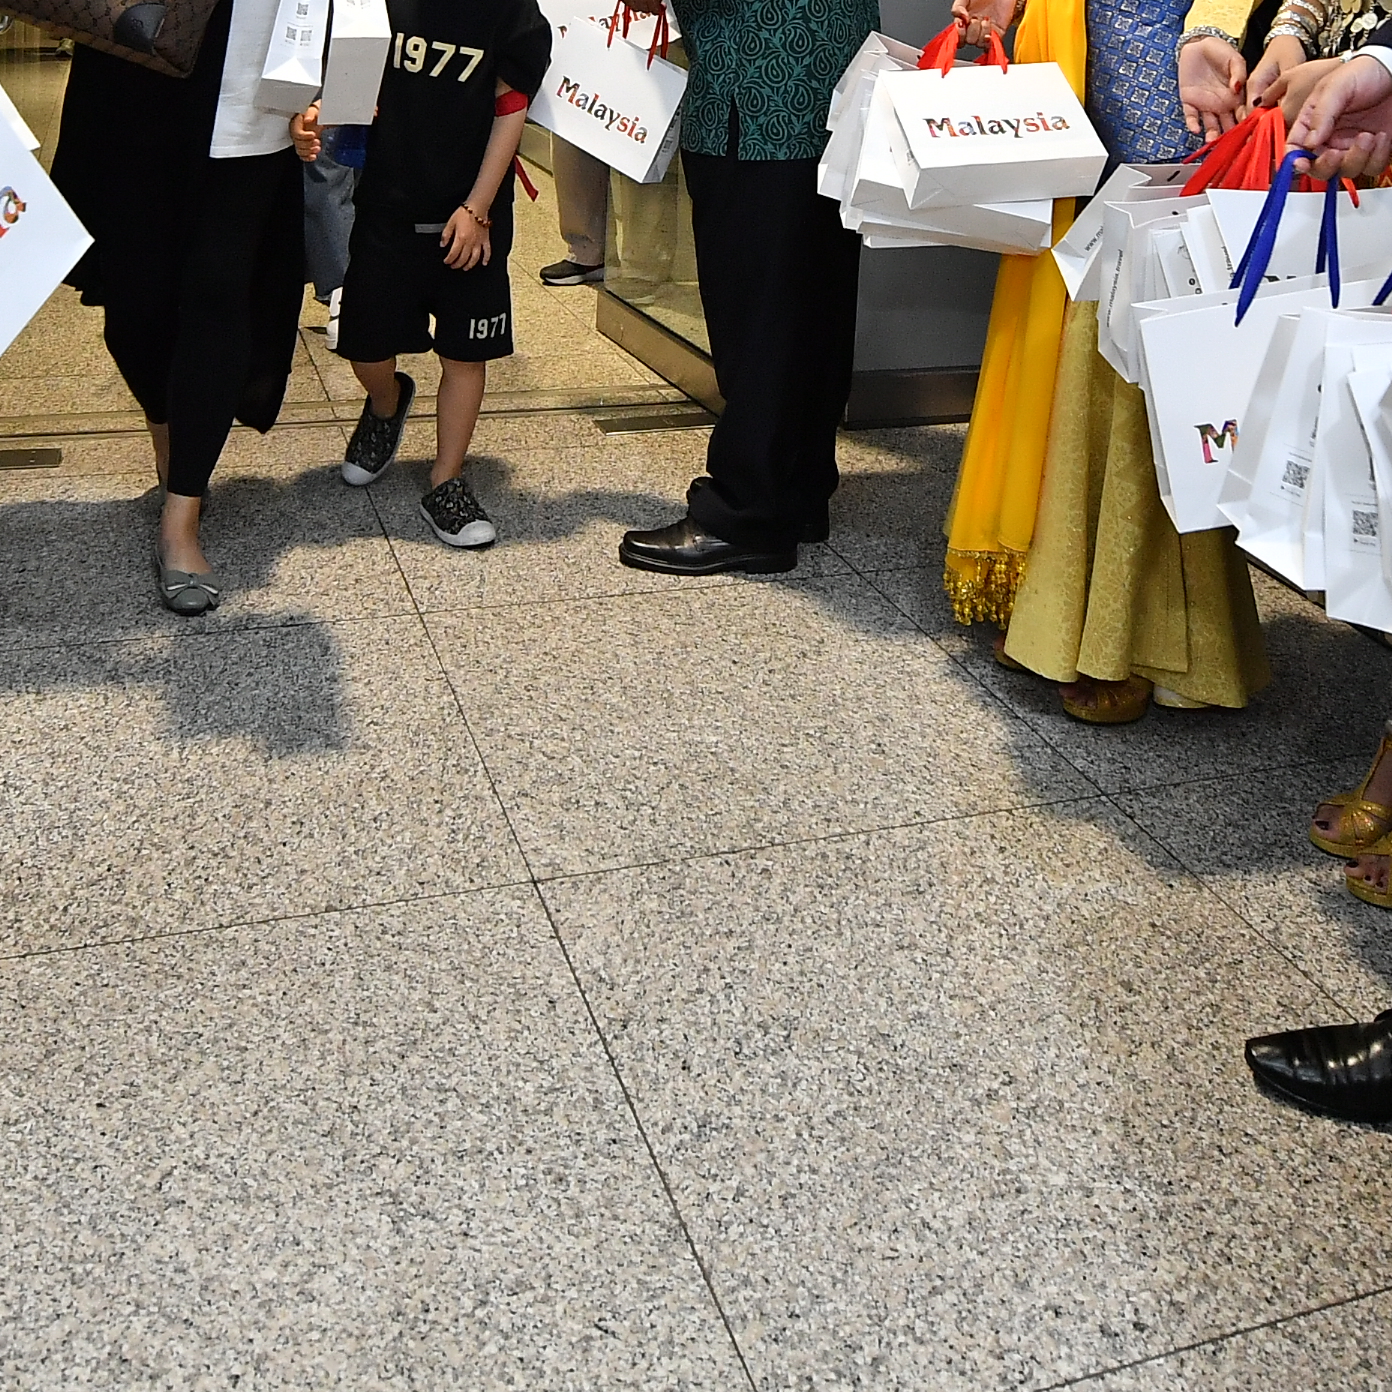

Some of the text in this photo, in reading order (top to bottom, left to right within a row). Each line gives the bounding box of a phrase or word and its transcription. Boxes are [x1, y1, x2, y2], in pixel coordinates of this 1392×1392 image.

[394, 32, 484, 82] 1977
[557, 74, 649, 144] Malaysia
[922, 112, 1071, 139] Malaysia
[468, 312, 507, 339] 1977
